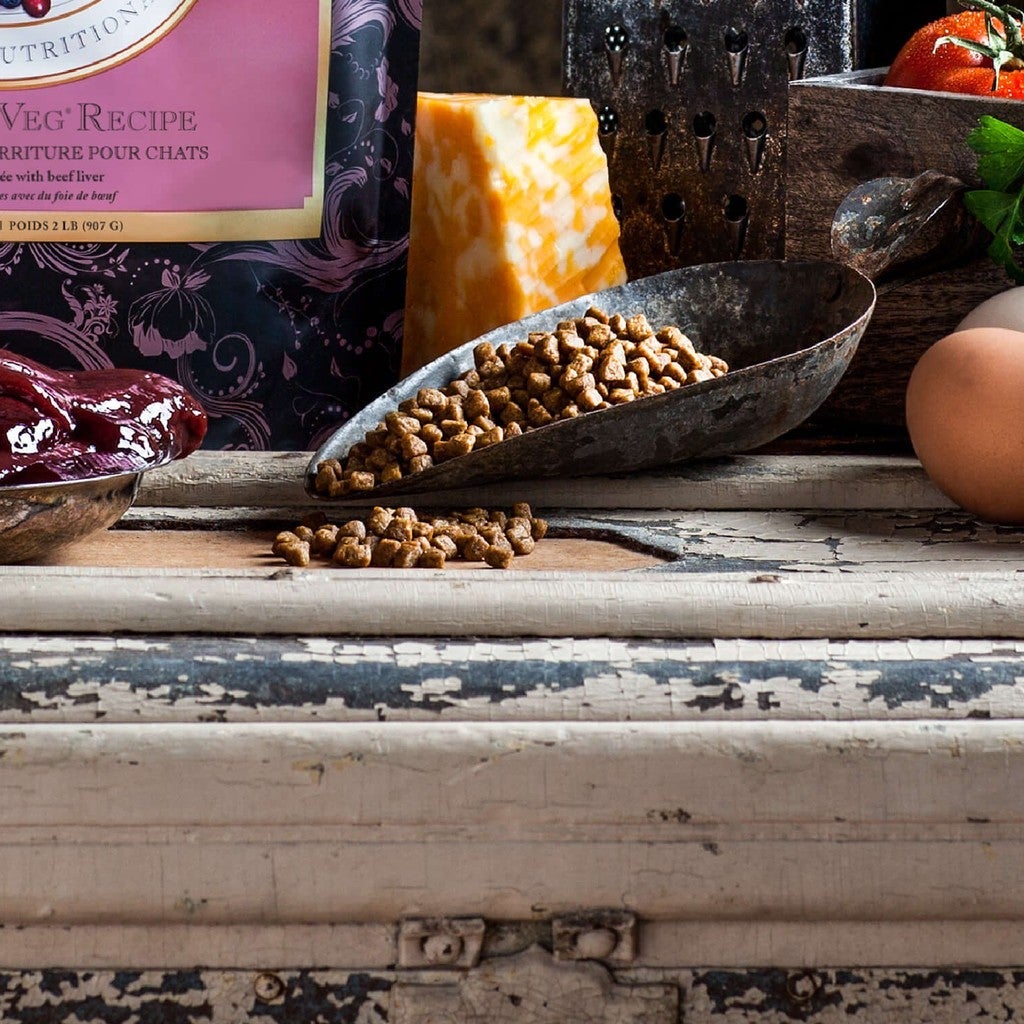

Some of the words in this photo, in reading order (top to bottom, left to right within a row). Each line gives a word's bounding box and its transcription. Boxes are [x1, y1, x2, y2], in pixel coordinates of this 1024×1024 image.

[77, 102, 198, 132] RECIPE
[88, 145, 141, 161] POUR
[145, 145, 209, 161] CHATS
[15, 170, 44, 182] with
[47, 169, 76, 182] beef
[77, 170, 105, 182] liver
[11, 192, 36, 201] avec
[37, 190, 52, 201] du
[51, 190, 74, 204] foie
[76, 190, 90, 201] de
[9, 221, 49, 231] POIDS
[52, 221, 59, 231] 2
[62, 221, 79, 231] LB
[82, 221, 106, 233] (907
[109, 221, 124, 233] G)
